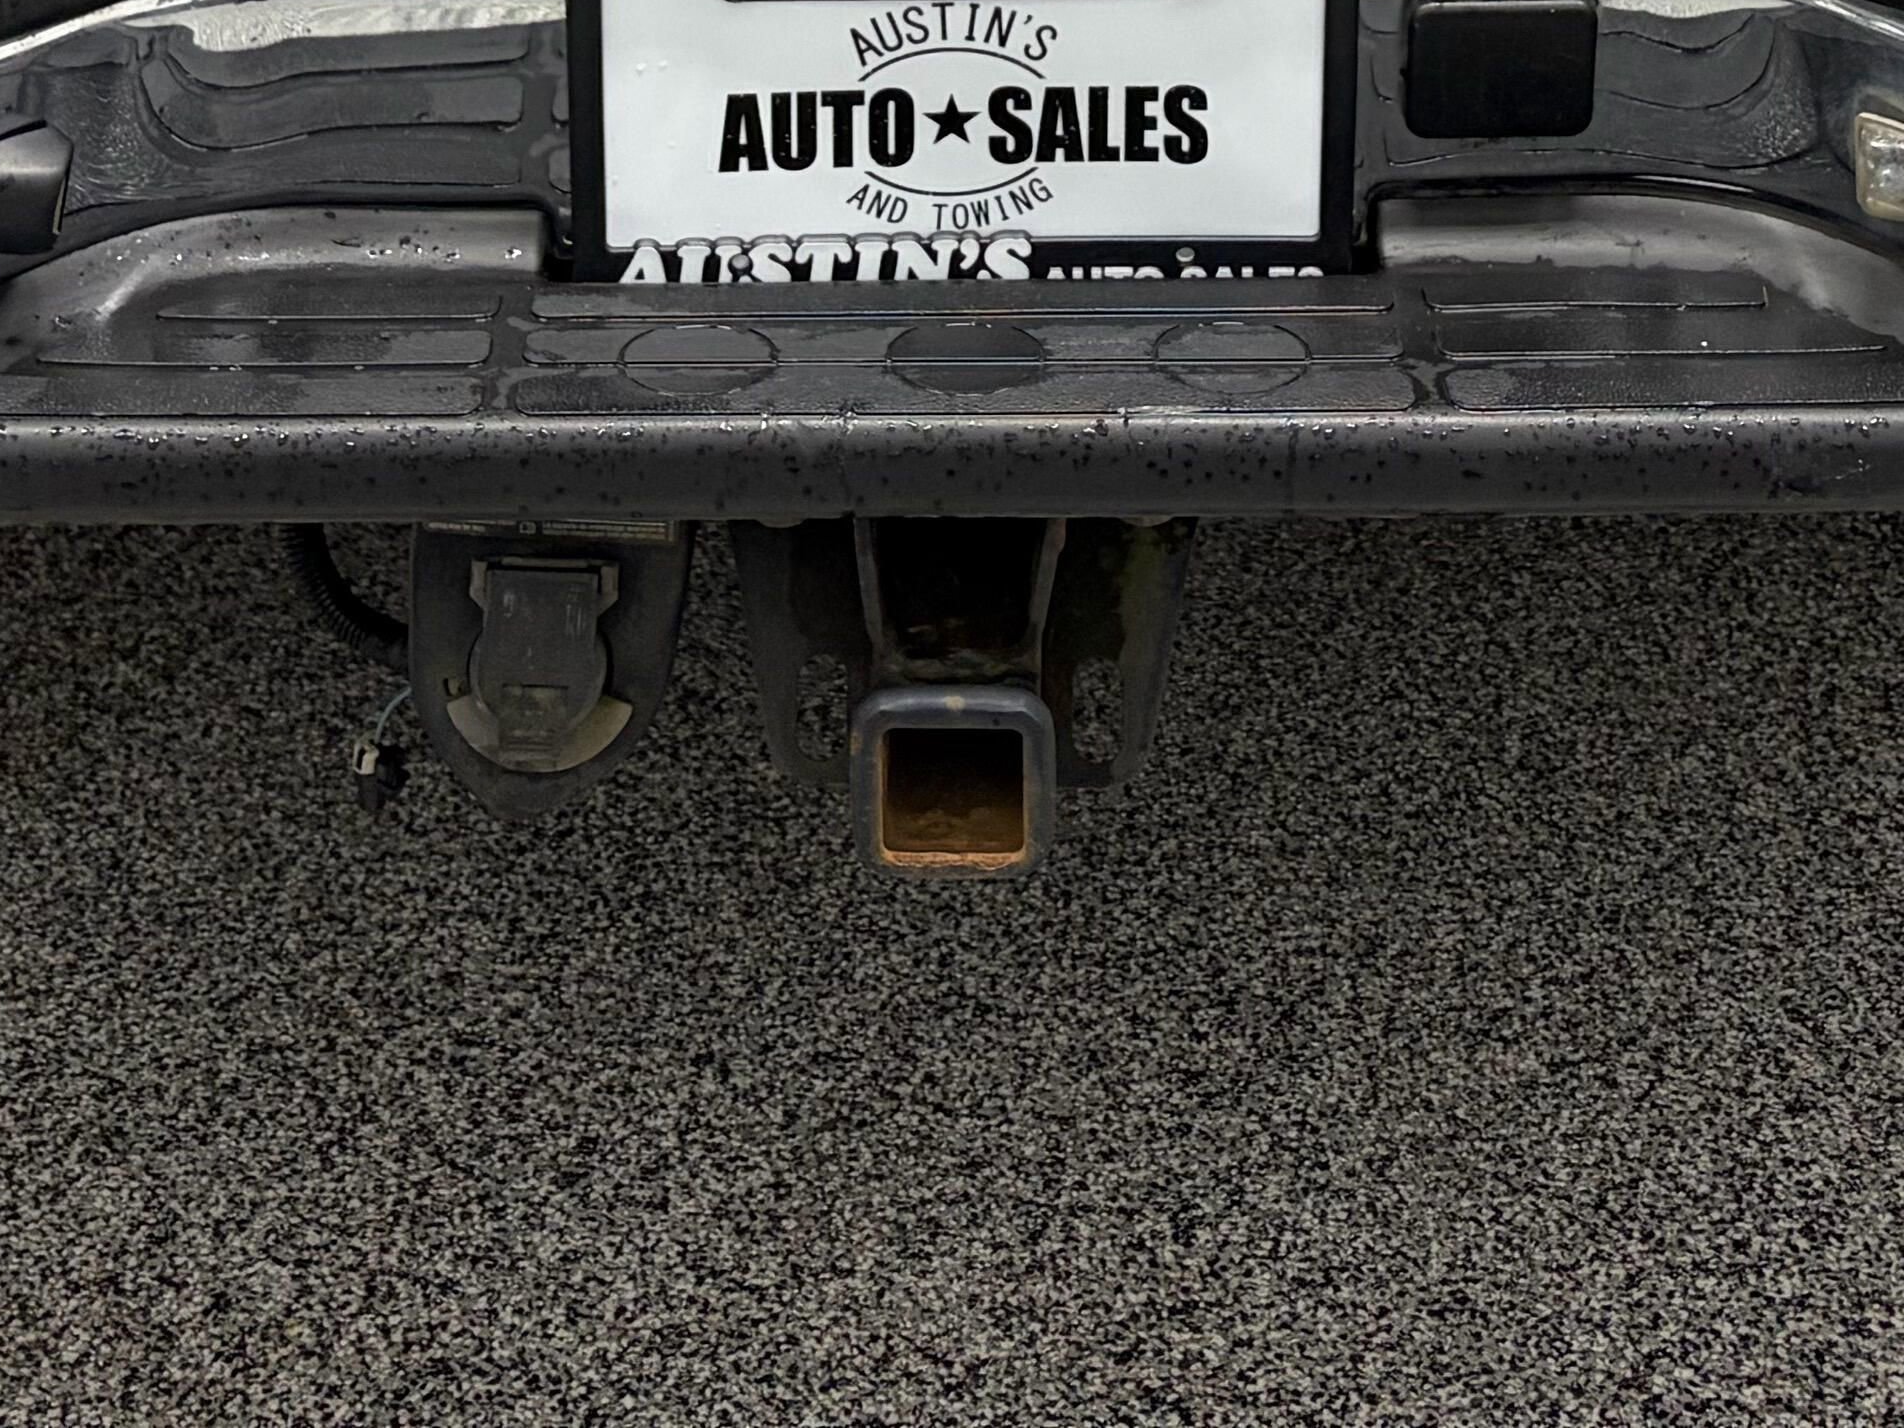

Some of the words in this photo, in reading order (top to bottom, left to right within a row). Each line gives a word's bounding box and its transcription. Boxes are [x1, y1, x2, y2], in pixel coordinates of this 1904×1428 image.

[848, 1, 1058, 68] AUSTIN'S
[717, 86, 915, 173] AUTO
[987, 84, 1209, 165] SALES
[845, 183, 909, 224] AND
[931, 177, 1055, 231] TOWING
